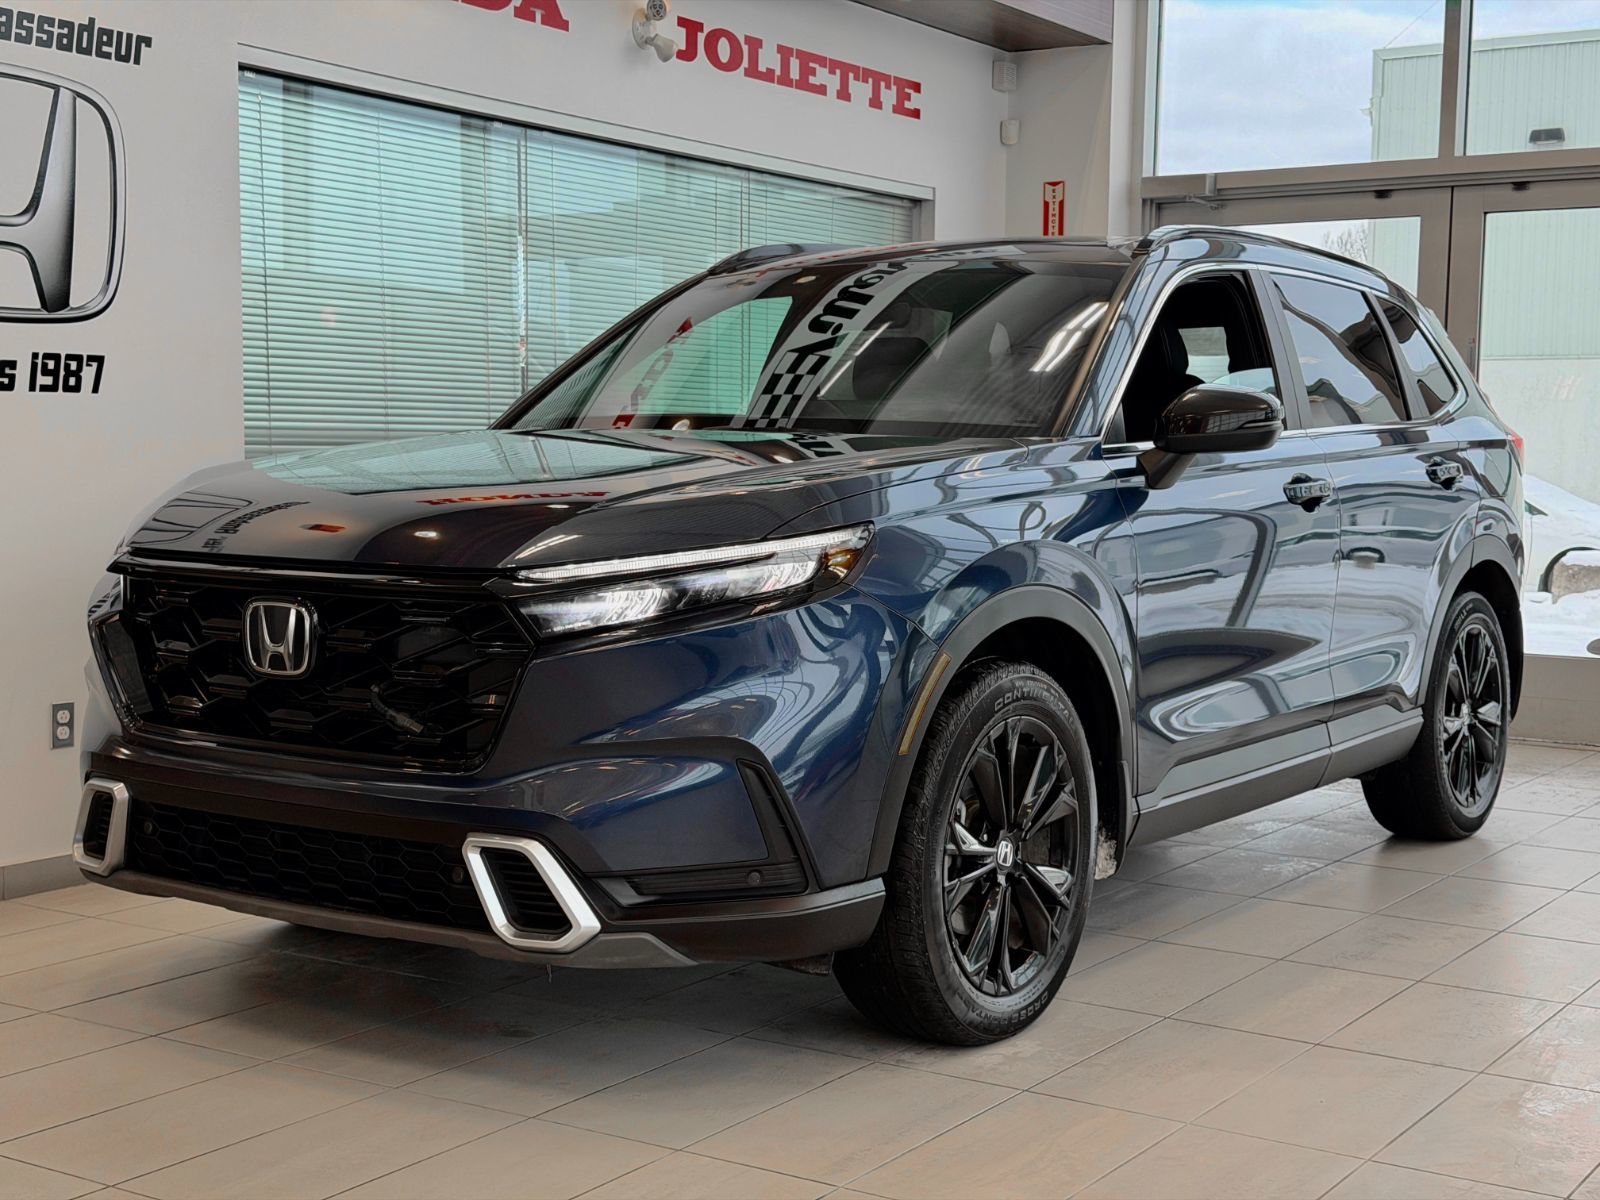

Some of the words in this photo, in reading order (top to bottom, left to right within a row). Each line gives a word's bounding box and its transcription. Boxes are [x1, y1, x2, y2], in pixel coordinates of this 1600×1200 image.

[0, 7, 152, 65] assadeur
[460, 0, 569, 32] A
[676, 15, 921, 120] JOLIETTE
[28, 352, 105, 393] 1987
